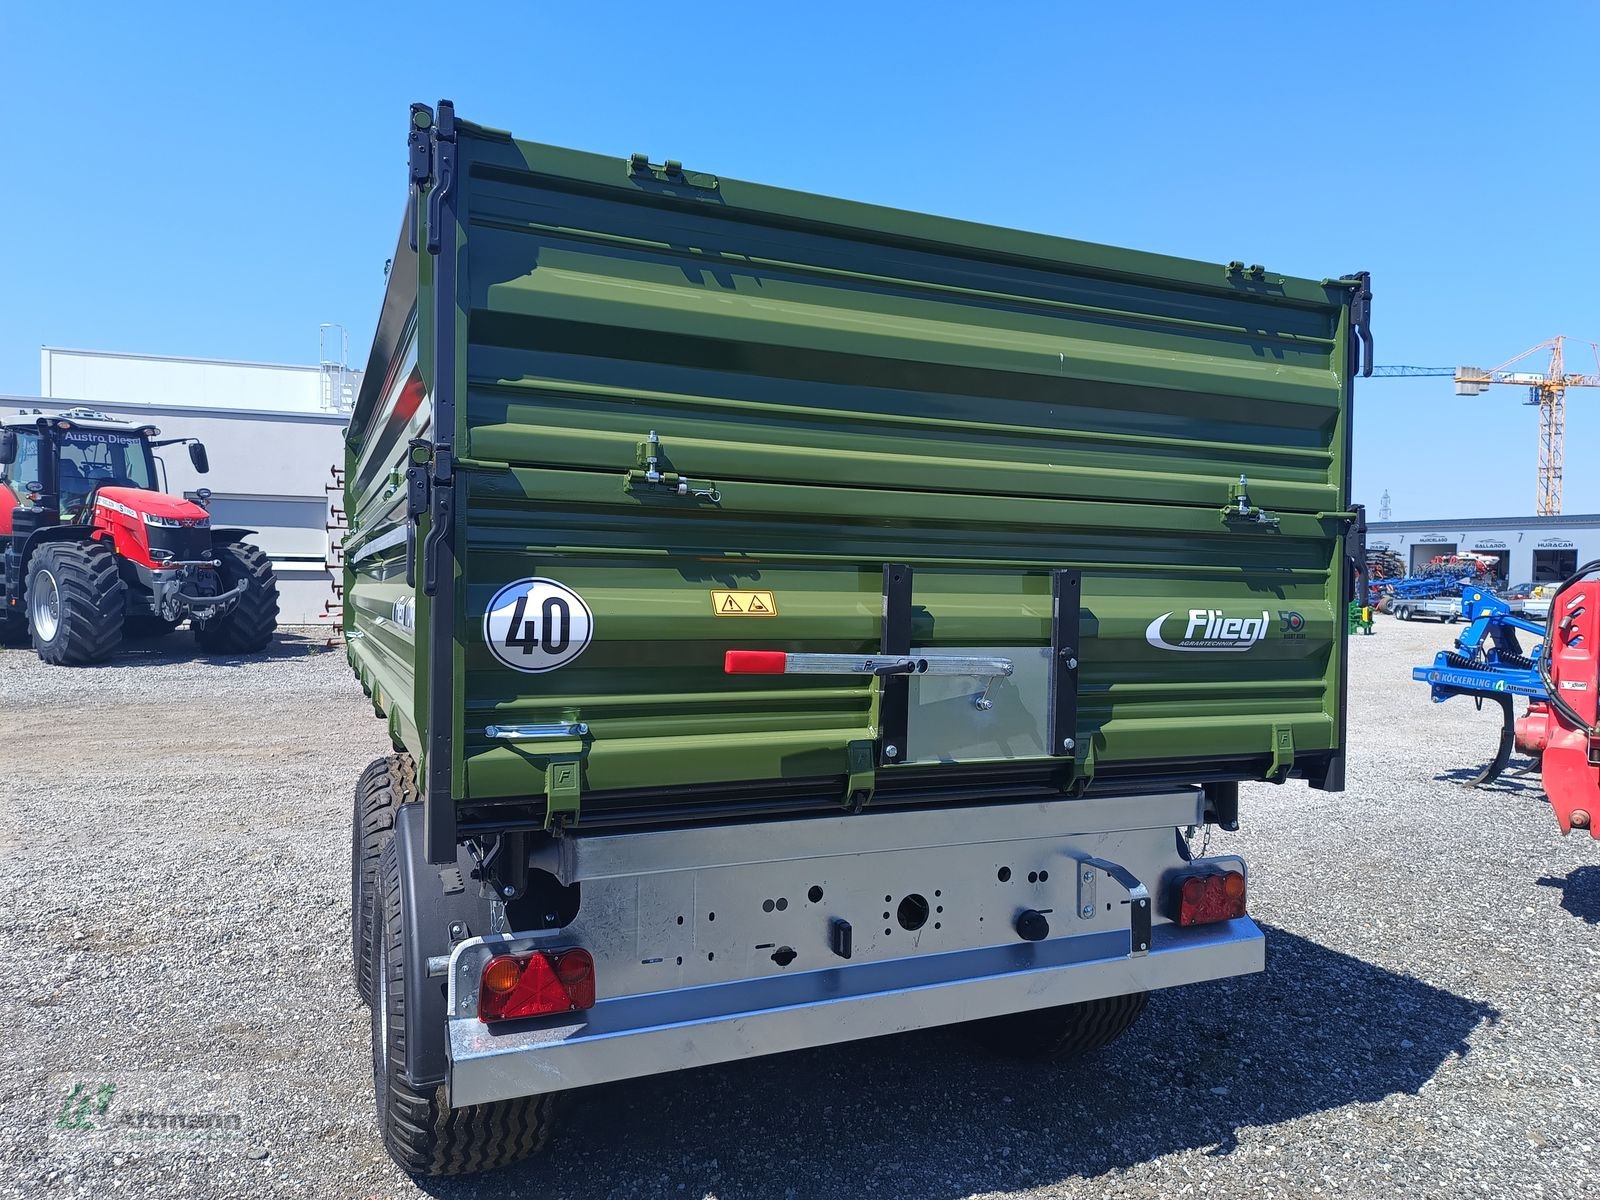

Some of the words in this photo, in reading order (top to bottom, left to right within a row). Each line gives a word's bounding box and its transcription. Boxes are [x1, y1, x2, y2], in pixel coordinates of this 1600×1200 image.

[65, 431, 105, 442] Austro
[505, 596, 570, 655] 40
[1184, 609, 1270, 645] Fliegl
[1505, 684, 1537, 694] Altmann
